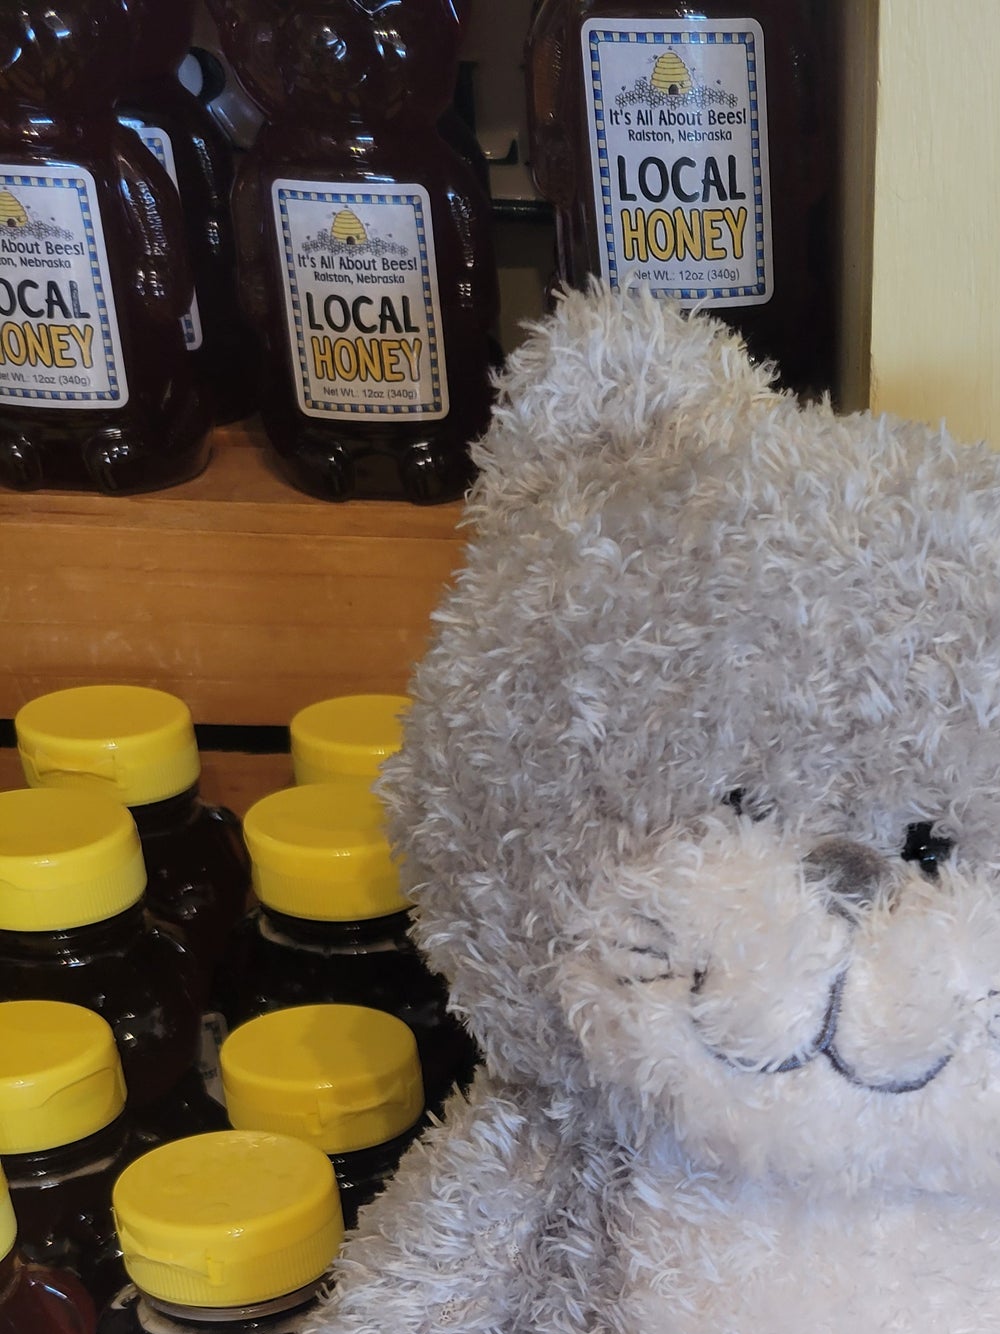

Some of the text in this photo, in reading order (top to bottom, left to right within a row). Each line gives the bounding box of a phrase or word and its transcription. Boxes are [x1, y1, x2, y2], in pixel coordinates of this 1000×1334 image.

[609, 108, 747, 126] It's All About Bees!
[628, 129, 733, 144] Ralston, Nebraska
[617, 154, 747, 203] LOCAL
[621, 206, 748, 262] HONEY
[1, 238, 85, 256] About Bees!
[0, 256, 72, 269] on, Nebraska
[297, 253, 418, 271] It's All About Bees!
[314, 271, 405, 284] Ralston, Nebraska
[634, 270, 652, 281] Net
[679, 270, 704, 281] 12oz
[707, 269, 740, 282] (340g)
[305, 291, 421, 334] LOCAL
[0, 320, 94, 369] ONEY
[310, 335, 423, 382] HONEY
[33, 373, 56, 384] 12oz
[58, 375, 92, 387] (340g)
[323, 386, 339, 397] Net
[362, 388, 385, 399] 12oz
[387, 389, 418, 400] (340g)
